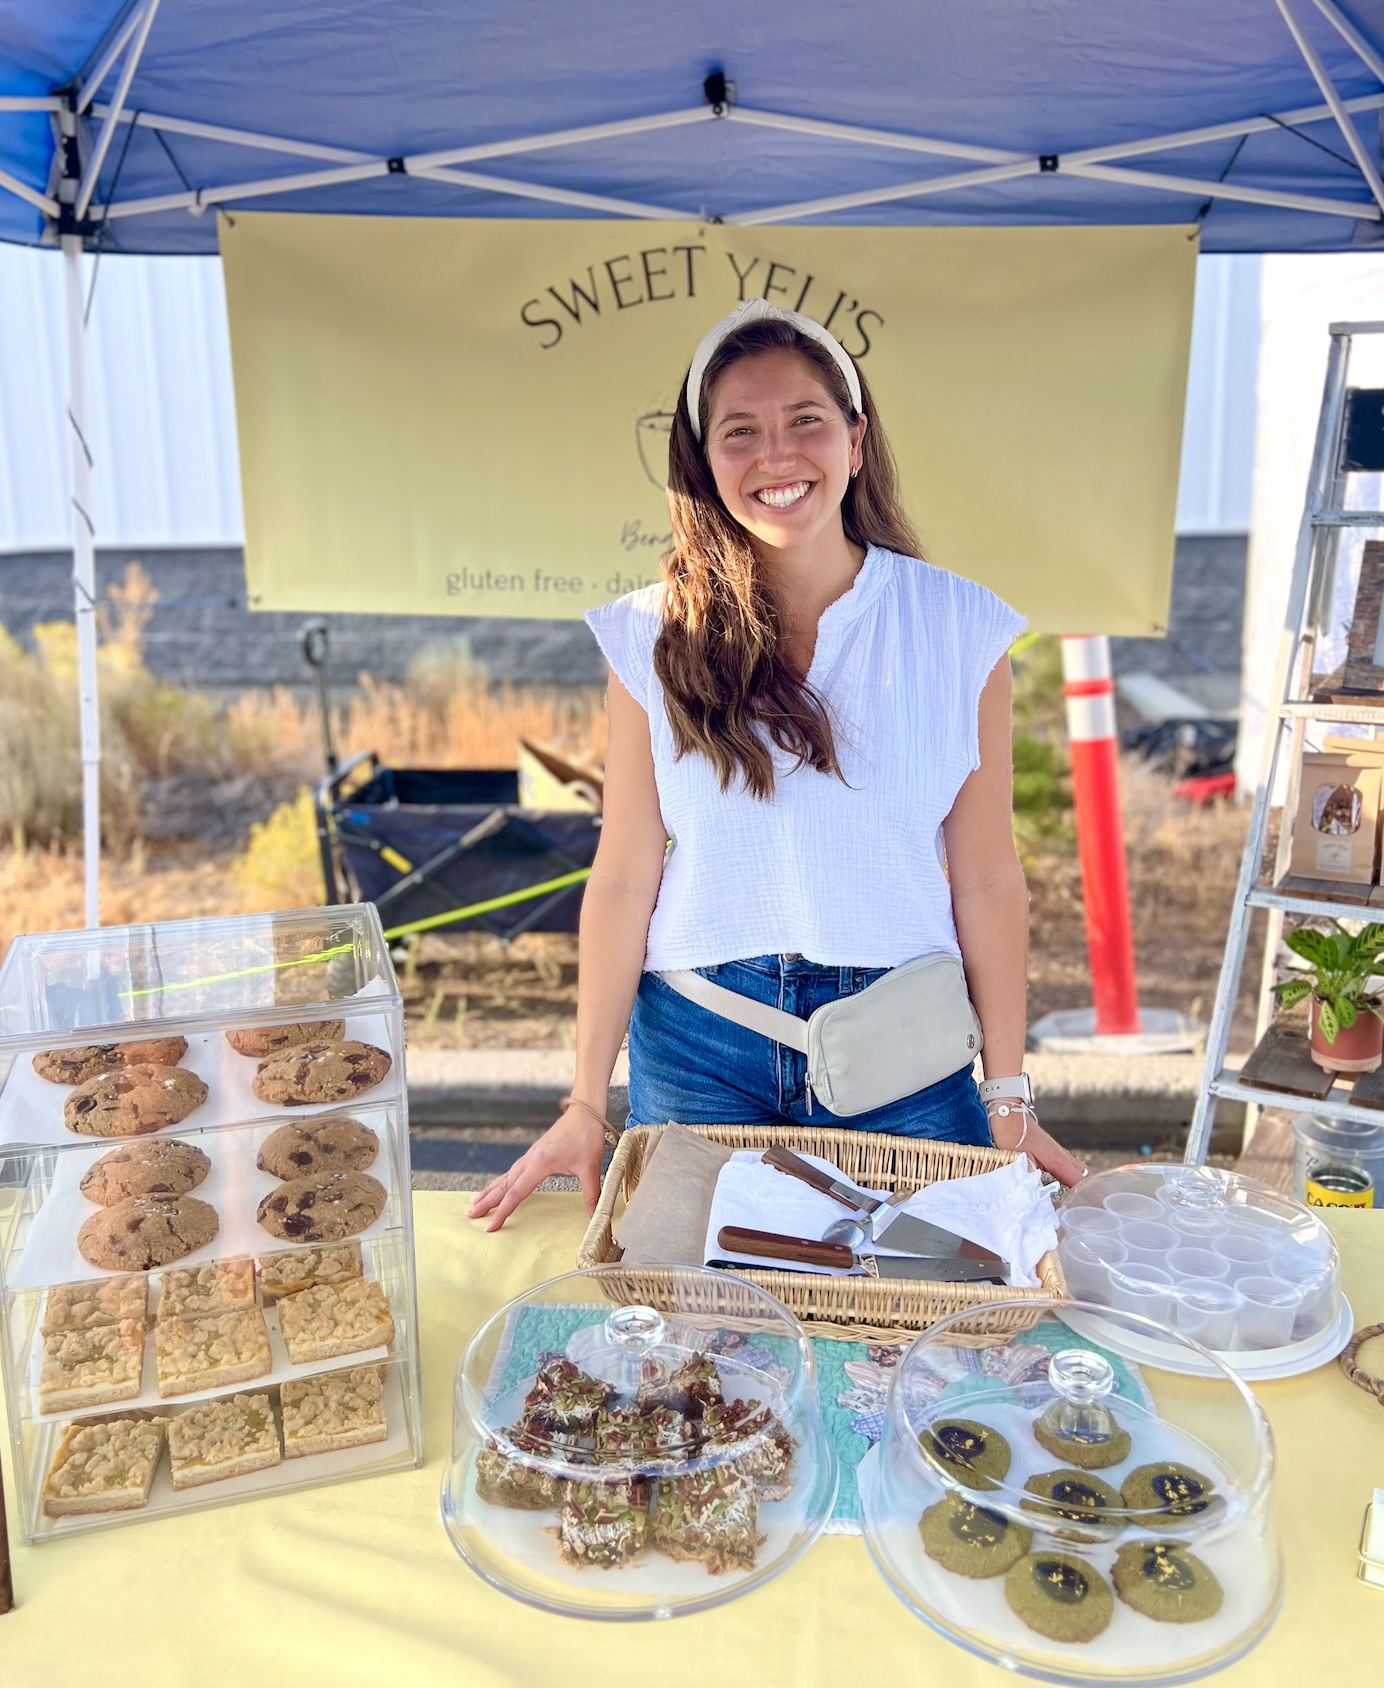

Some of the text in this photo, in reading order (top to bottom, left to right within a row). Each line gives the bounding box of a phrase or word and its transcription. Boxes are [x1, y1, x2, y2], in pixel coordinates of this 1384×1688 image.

[520, 245, 707, 349] SWEET
[446, 567, 525, 596] gluten
[533, 568, 584, 594] free
